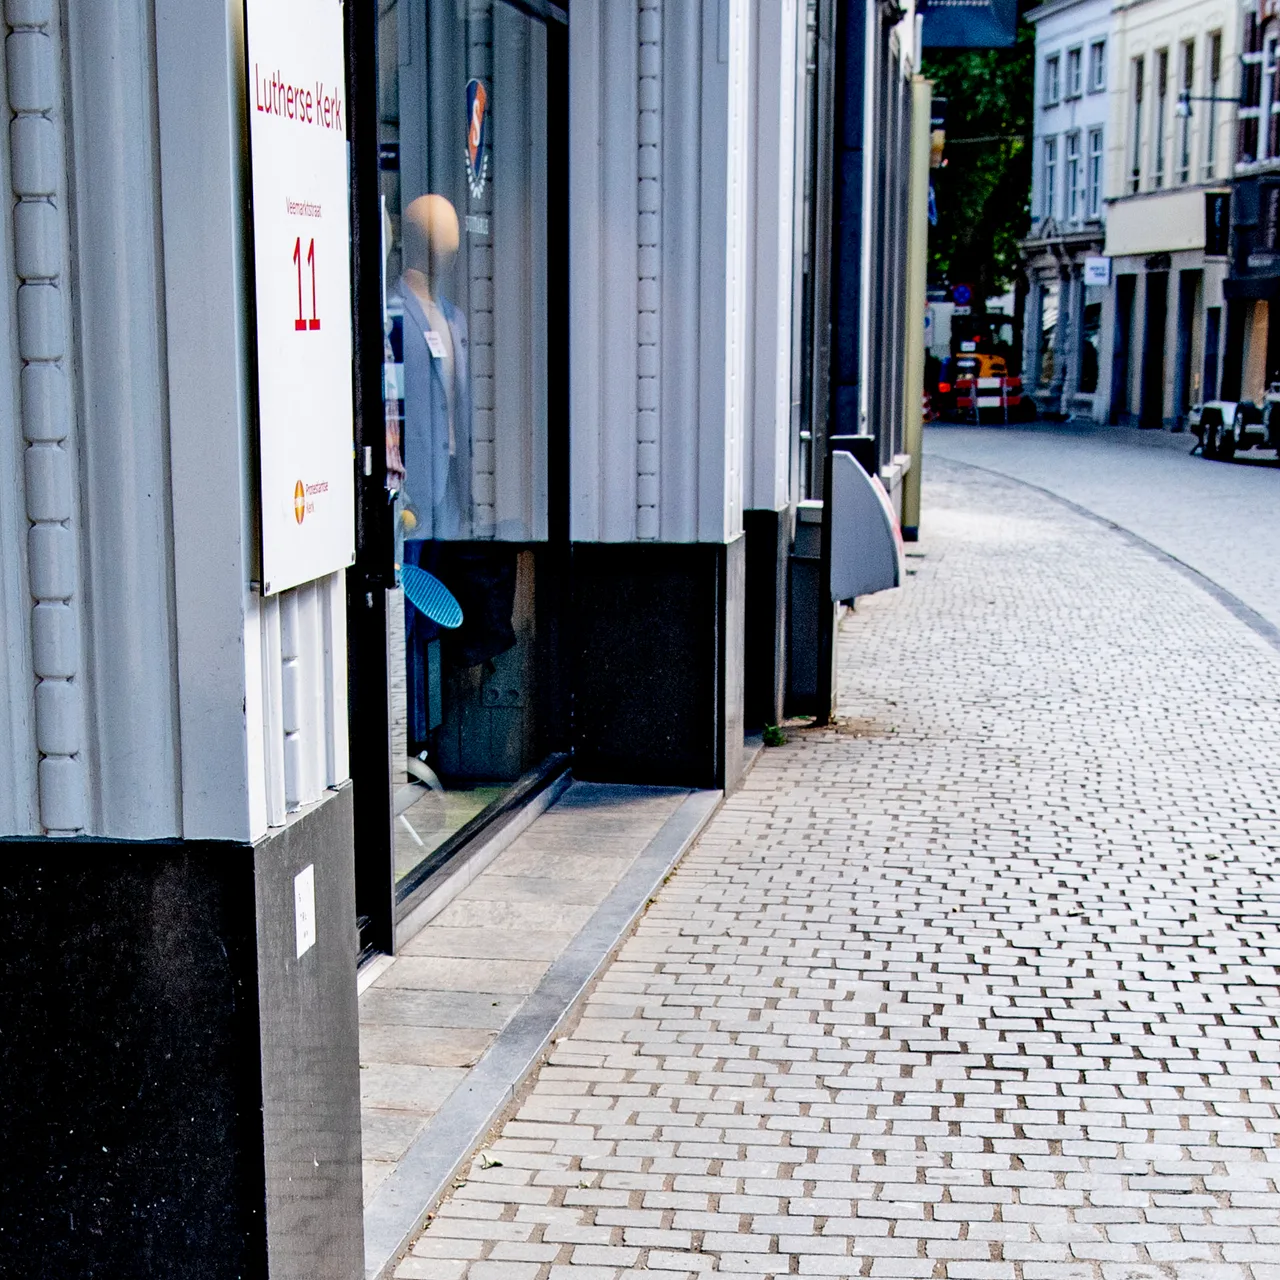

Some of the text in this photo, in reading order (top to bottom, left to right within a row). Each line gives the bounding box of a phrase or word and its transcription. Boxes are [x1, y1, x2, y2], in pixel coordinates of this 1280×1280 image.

[255, 62, 343, 132] Lutherse Kerk
[286, 197, 322, 219] Veemarktstraat
[293, 236, 321, 331] 11
